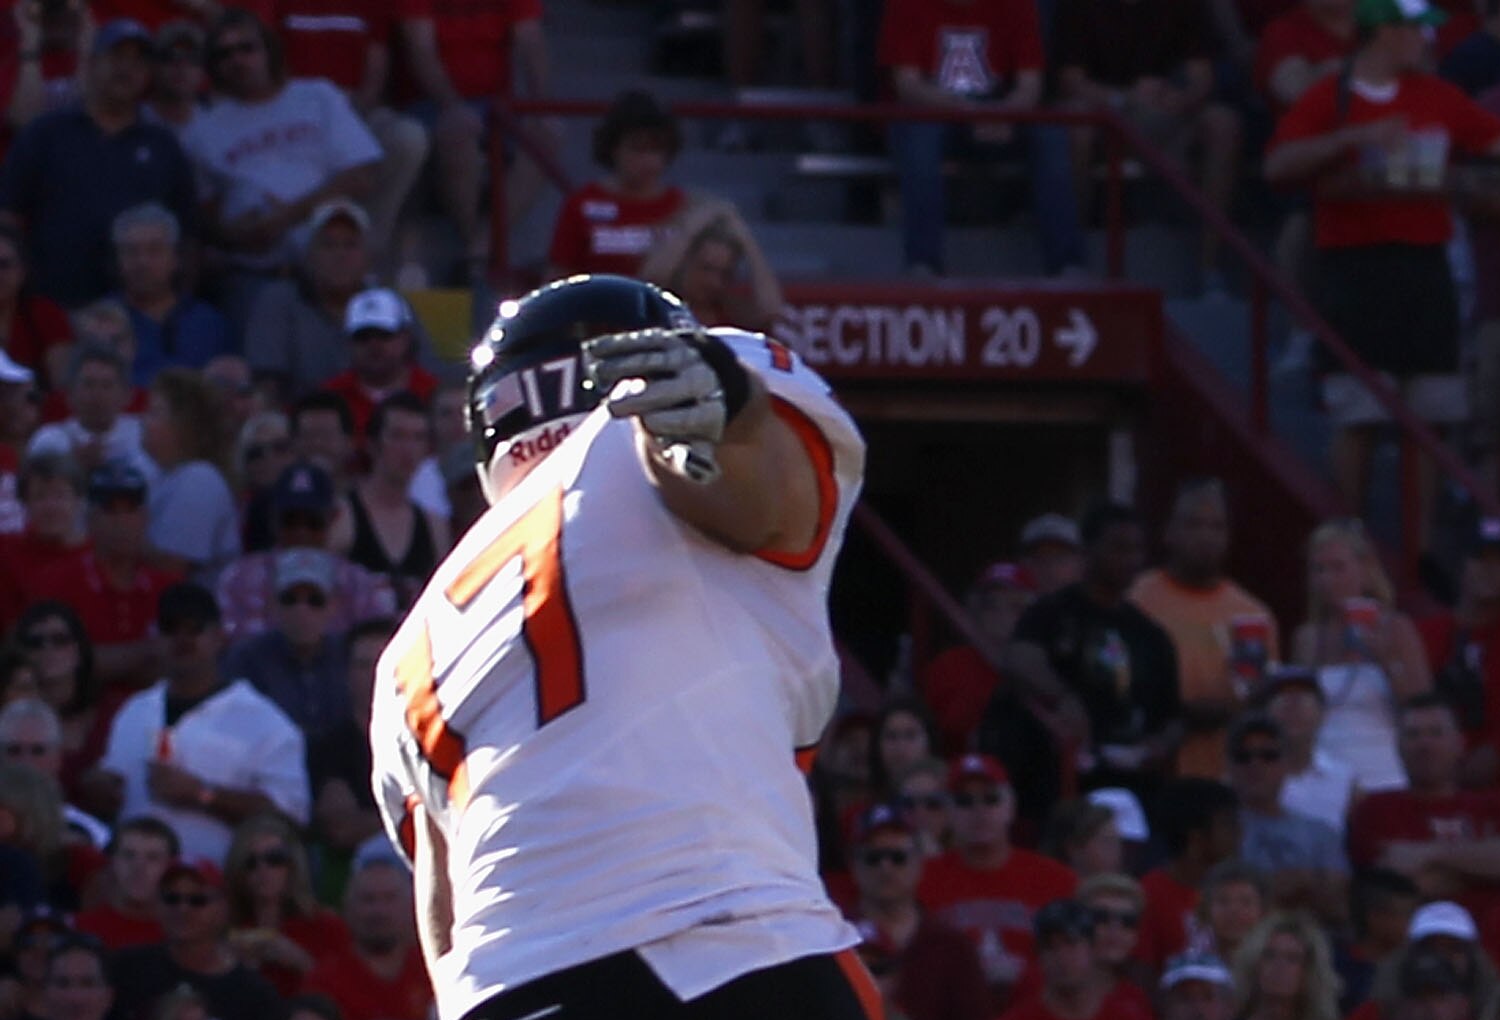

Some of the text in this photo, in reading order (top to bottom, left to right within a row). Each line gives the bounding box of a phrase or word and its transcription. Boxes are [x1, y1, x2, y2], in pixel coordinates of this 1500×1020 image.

[770, 304, 1042, 367] SECTION 20
[521, 356, 577, 418] 17
